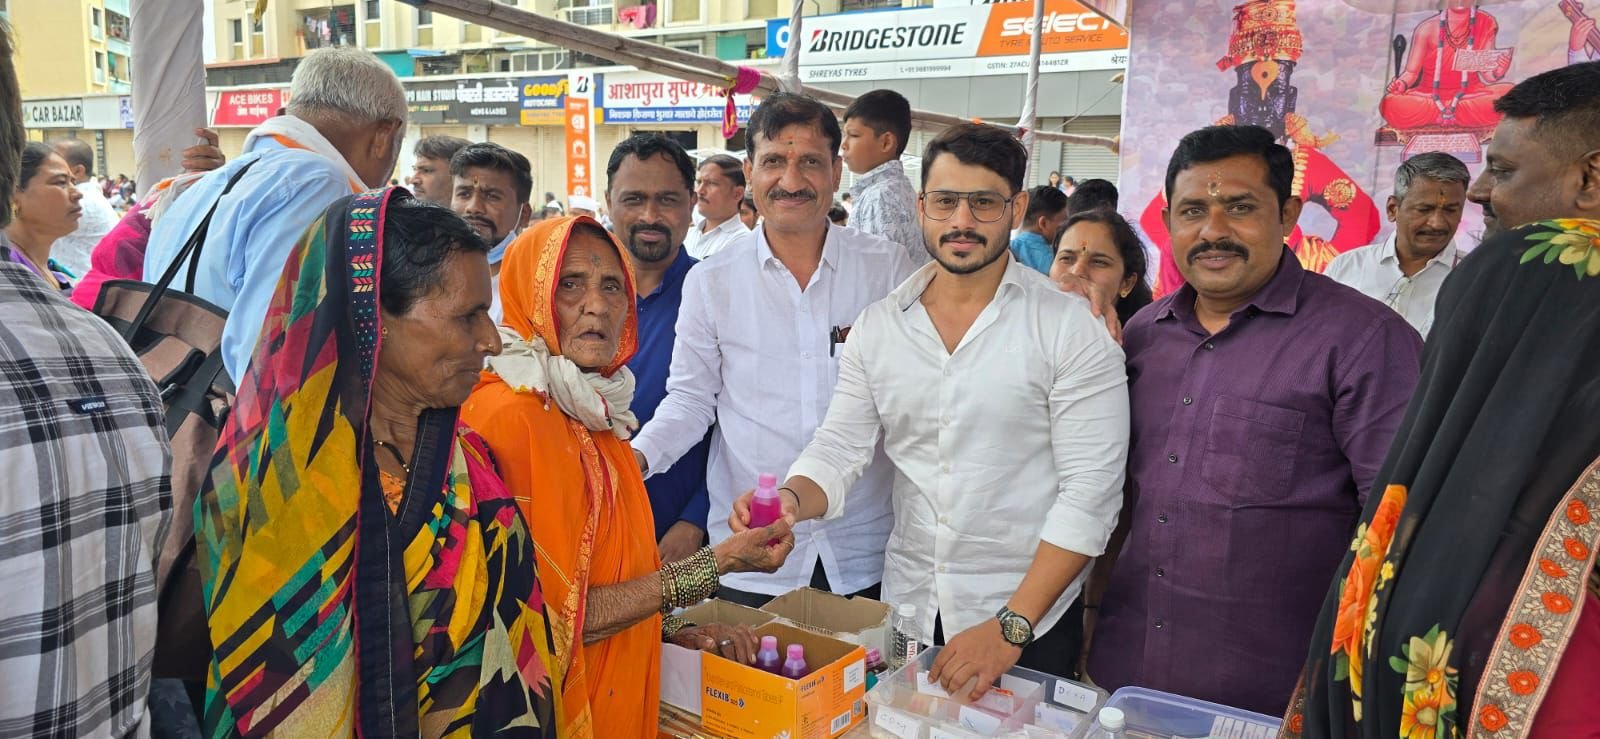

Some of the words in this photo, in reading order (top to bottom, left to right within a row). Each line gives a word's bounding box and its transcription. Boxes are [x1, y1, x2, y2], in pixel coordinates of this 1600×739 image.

[808, 22, 967, 53] BRIDGESTONE
[1000, 38, 1024, 47] TYRE
[1064, 33, 1105, 44] SERVICE
[809, 69, 842, 79] SHREYAS
[844, 68, 868, 77] TYRES
[229, 94, 247, 105] ACE
[247, 93, 274, 105] BIKES
[432, 88, 456, 102] STUDIO
[608, 82, 664, 106] आशापुरा
[667, 80, 698, 105] सुपर
[32, 106, 49, 122] CAR
[52, 105, 83, 122] BAZAR
[705, 686, 730, 703] FLEXIB
